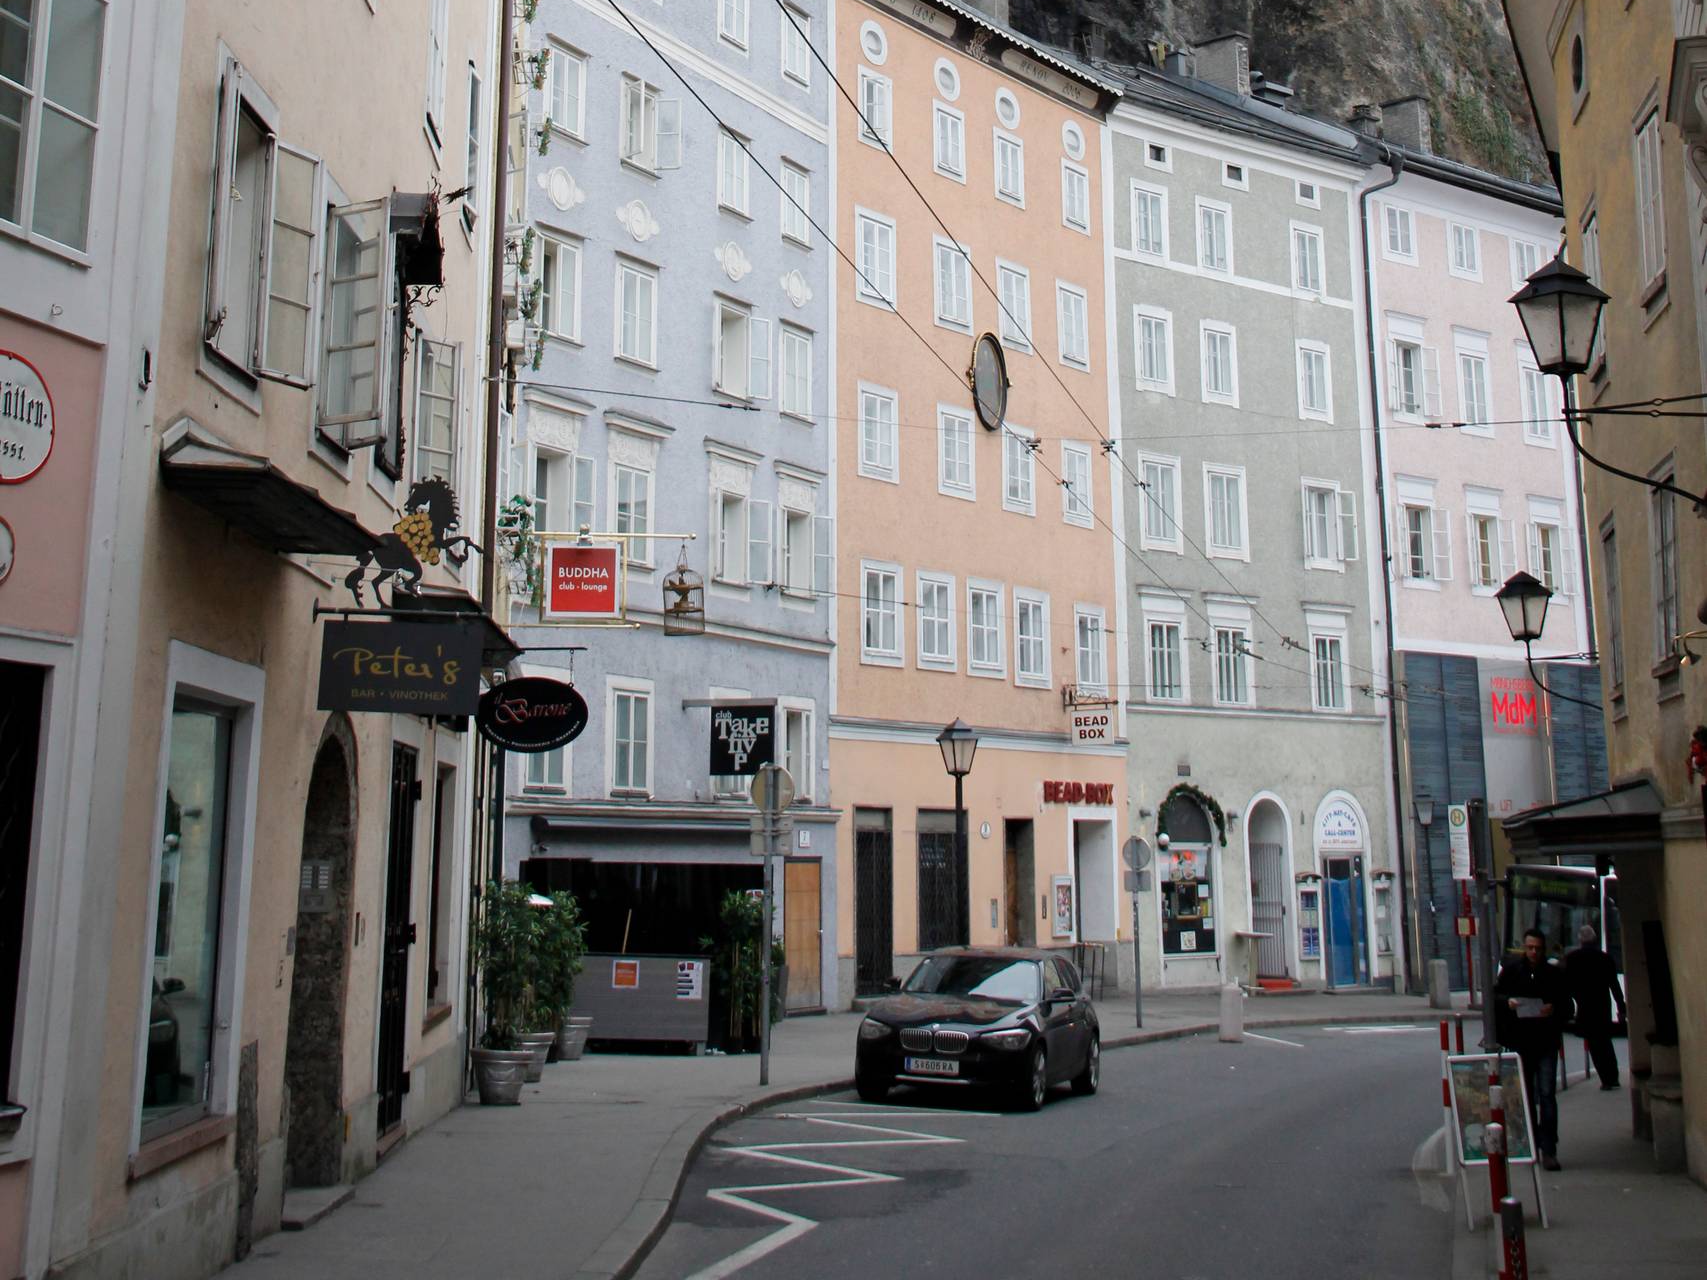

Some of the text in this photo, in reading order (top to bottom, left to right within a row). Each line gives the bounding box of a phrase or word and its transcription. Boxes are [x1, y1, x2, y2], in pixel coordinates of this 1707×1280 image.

[911, 3, 937, 24] 1408
[559, 567, 609, 578] BUDDHA
[559, 581, 608, 592] club lounge
[332, 644, 461, 685] Peter's
[351, 688, 448, 700] BAR VINOTHEK
[495, 698, 573, 724] Barone
[715, 710, 732, 719] club
[1491, 691, 1537, 726] MdM
[715, 717, 769, 740] Take
[1075, 715, 1109, 727] BEAD
[1079, 728, 1105, 739] BOX
[1044, 781, 1114, 805] BEAD-BOX
